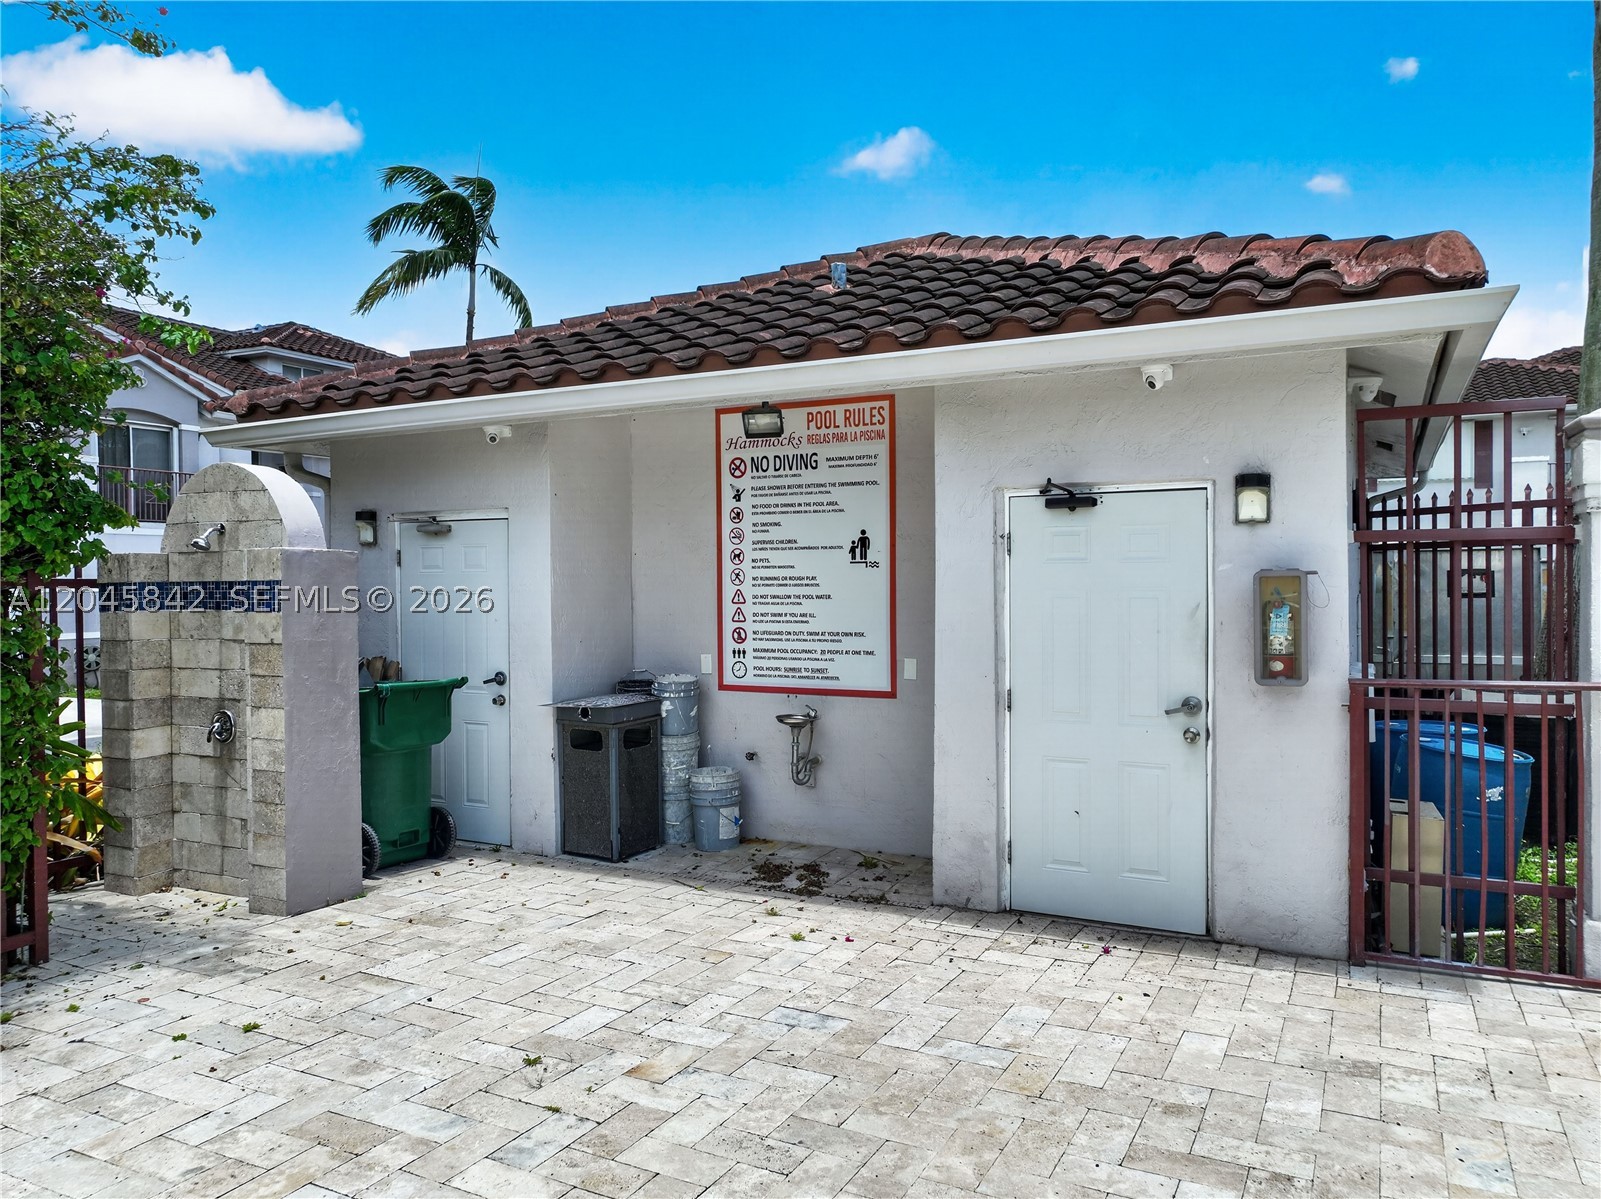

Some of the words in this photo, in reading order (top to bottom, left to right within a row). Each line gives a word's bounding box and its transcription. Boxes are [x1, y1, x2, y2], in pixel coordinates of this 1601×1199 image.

[807, 410, 840, 430] POOL
[844, 406, 885, 427] RULES
[725, 432, 803, 450] Hammocks
[807, 434, 830, 445] REGLAS
[832, 433, 848, 443] PARA
[850, 432, 857, 441] LA
[860, 430, 885, 441] PISCINA
[751, 456, 769, 473] NO
[774, 453, 818, 471] DIVING
